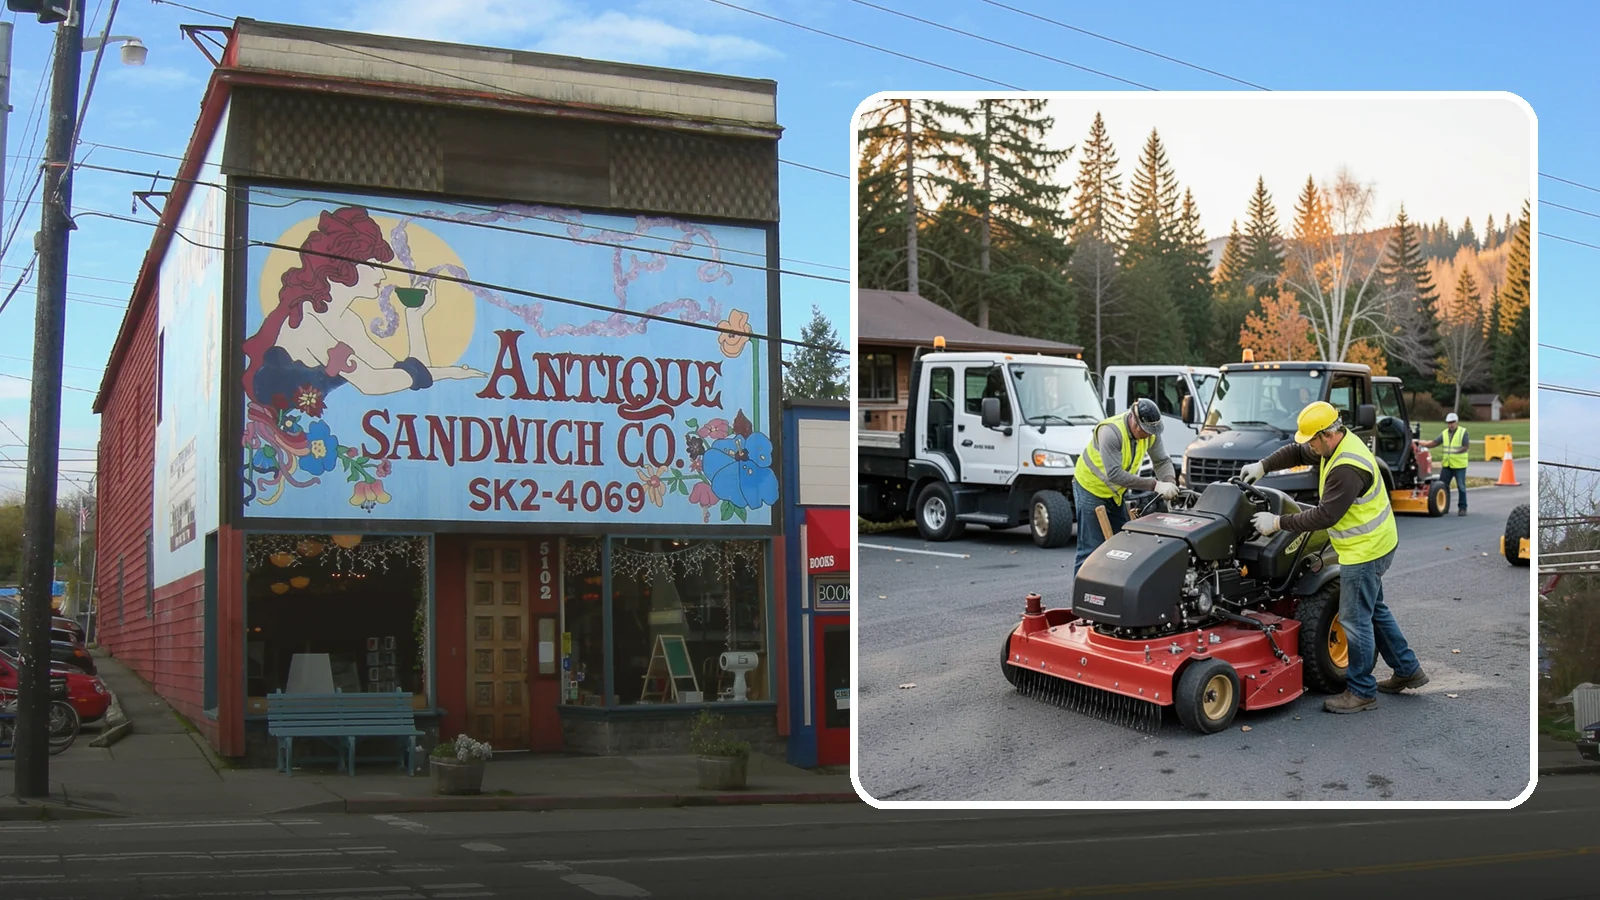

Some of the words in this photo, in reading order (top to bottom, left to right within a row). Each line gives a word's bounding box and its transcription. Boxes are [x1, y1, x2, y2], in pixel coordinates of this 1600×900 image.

[476, 329, 724, 421] ANTIQUE
[360, 409, 604, 468] SANDWICH
[617, 422, 685, 469] CO.
[468, 477, 646, 513] SK2-4069
[539, 542, 552, 600] 5102
[809, 555, 835, 569] BOOKS
